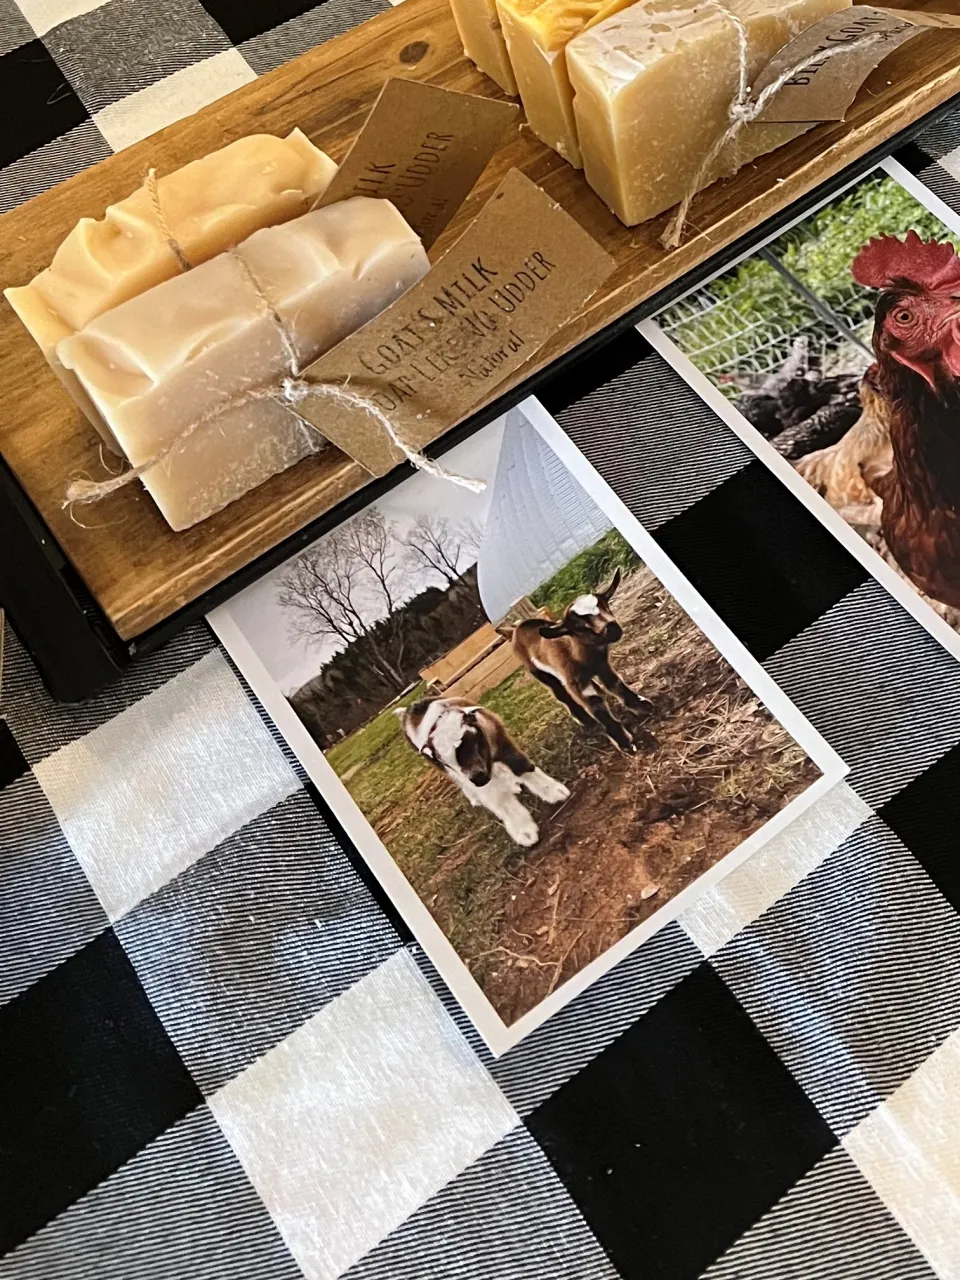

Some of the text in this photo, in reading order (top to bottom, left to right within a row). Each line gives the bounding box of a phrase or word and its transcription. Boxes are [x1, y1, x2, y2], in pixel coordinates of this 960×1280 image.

[395, 131, 454, 188] UDDER
[433, 256, 498, 317] MILK
[464, 309, 498, 338] NO
[488, 251, 556, 314] UDDER
[459, 329, 526, 387] Natural
